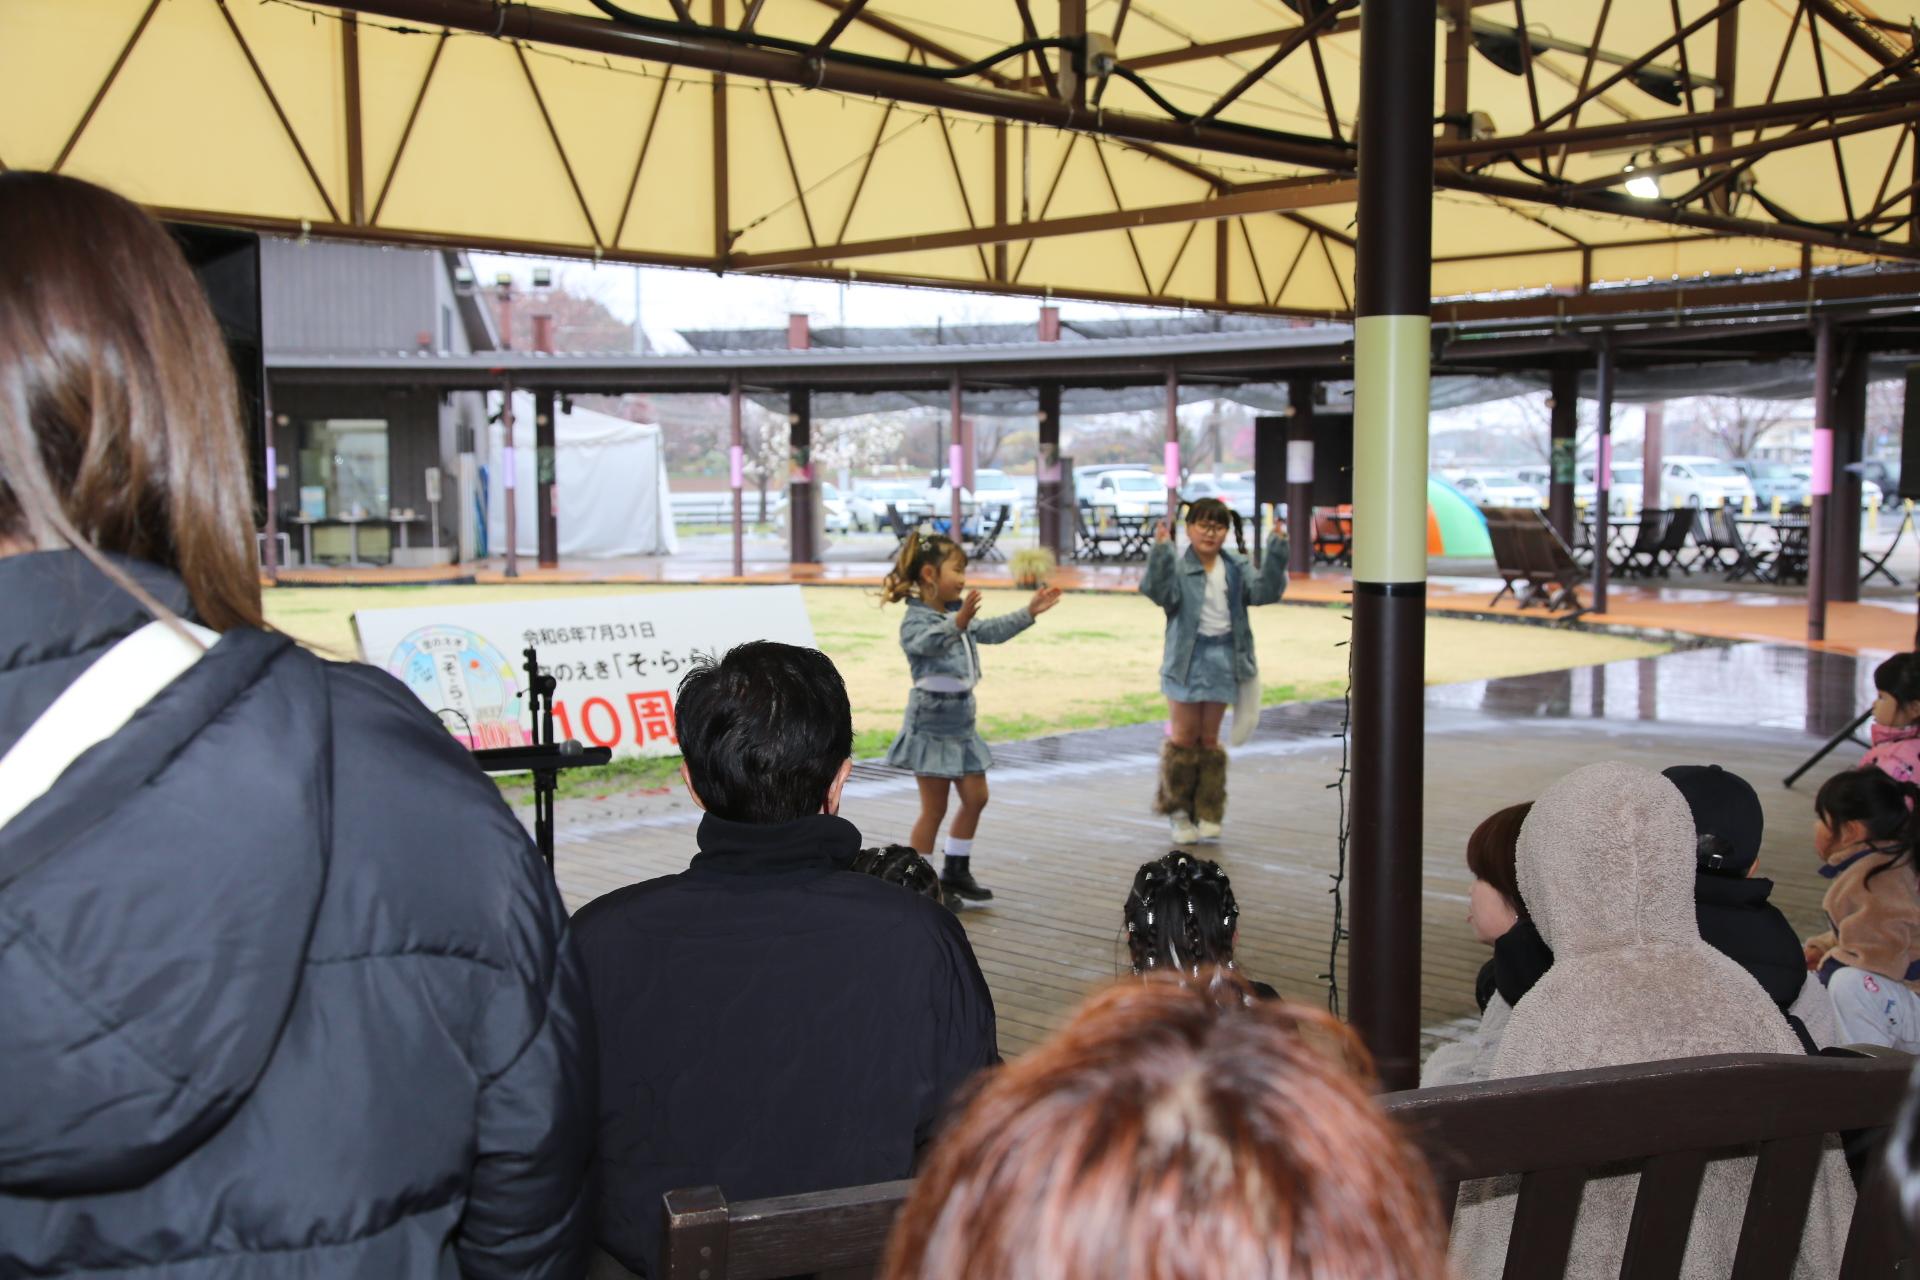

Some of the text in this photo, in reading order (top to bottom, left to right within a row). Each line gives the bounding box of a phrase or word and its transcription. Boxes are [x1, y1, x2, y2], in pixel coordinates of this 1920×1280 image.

[523, 621, 656, 645] 令和6年7月31日
